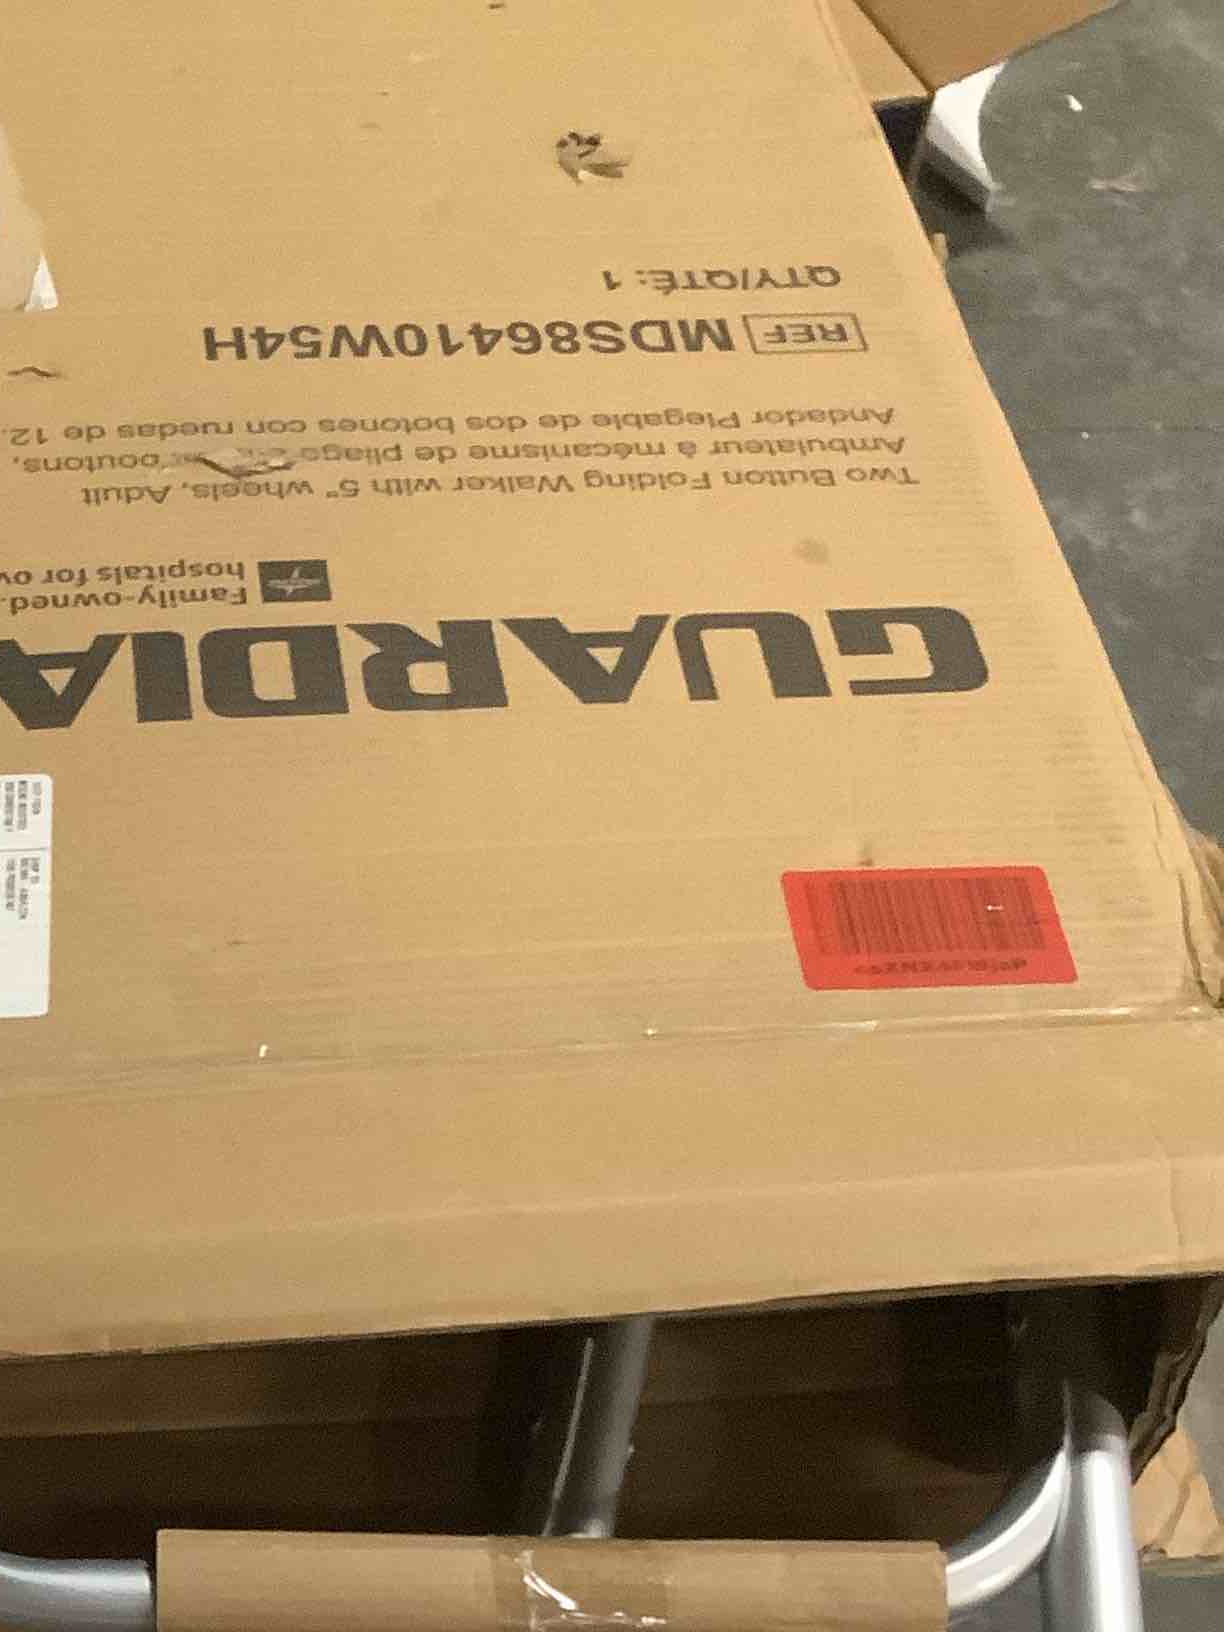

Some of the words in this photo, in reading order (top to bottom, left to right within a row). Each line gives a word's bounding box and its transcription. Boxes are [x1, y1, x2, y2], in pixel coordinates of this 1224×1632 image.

[600, 270, 621, 291] 1
[634, 265, 841, 295] QTY/QTÉ:
[202, 319, 736, 362] MDS86410W54H
[762, 323, 849, 345] REF
[245, 419, 307, 436] con
[319, 416, 454, 435] botones
[465, 415, 526, 433] dos
[538, 413, 580, 432] de
[592, 407, 741, 431] Plegable
[751, 407, 894, 427] Andador
[63, 424, 105, 443] de
[117, 421, 233, 442] ruedas
[414, 445, 457, 464] de
[468, 441, 666, 462] mécanisme
[677, 441, 697, 460] à
[708, 436, 905, 457] Ambulateur
[371, 477, 442, 497] with
[451, 474, 575, 494] Walker
[583, 469, 711, 492] Folding
[722, 468, 836, 488] Button
[845, 467, 920, 486] Two
[80, 485, 171, 507] Adult
[180, 479, 314, 503] wheels,
[325, 479, 360, 499] 5"
[42, 566, 88, 589] for
[96, 559, 246, 587] hospitals
[0, 585, 248, 616] Family-owned.
